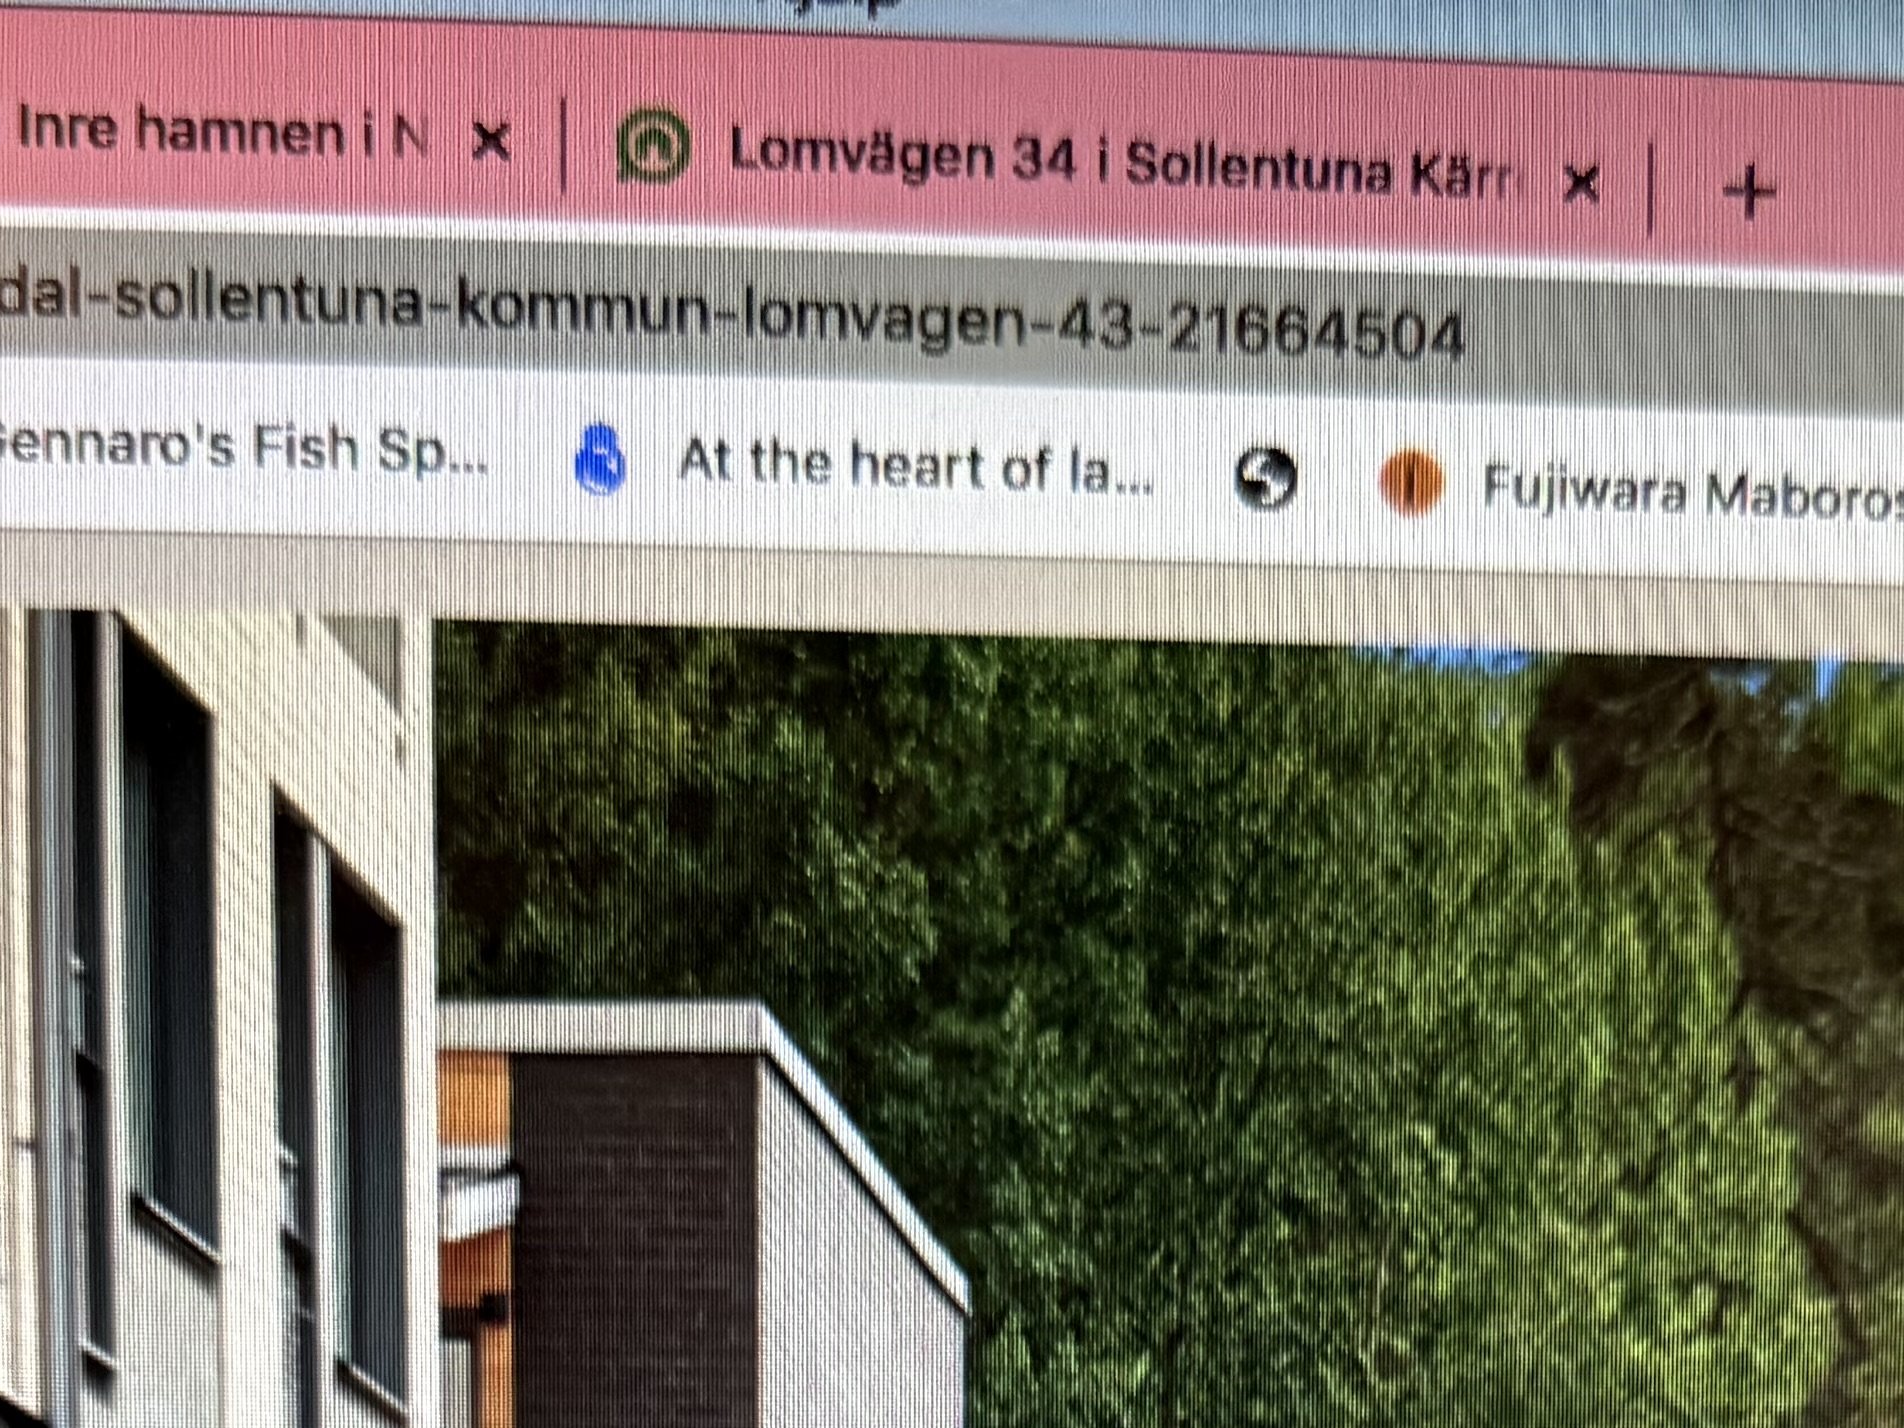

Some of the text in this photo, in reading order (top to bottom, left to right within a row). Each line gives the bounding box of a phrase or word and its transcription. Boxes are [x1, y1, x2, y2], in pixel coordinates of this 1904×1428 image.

[18, 102, 118, 150] Inre
[136, 103, 345, 156] hamnen
[362, 108, 374, 157] i
[393, 112, 428, 158] N
[731, 123, 1524, 199] Lomvägen 34 i Sollentuna Kärr
[253, 421, 359, 472] Fish
[378, 426, 489, 482] Sp...
[679, 435, 1154, 497] At the heart of la...
[1483, 461, 1688, 521] Fujiwara
